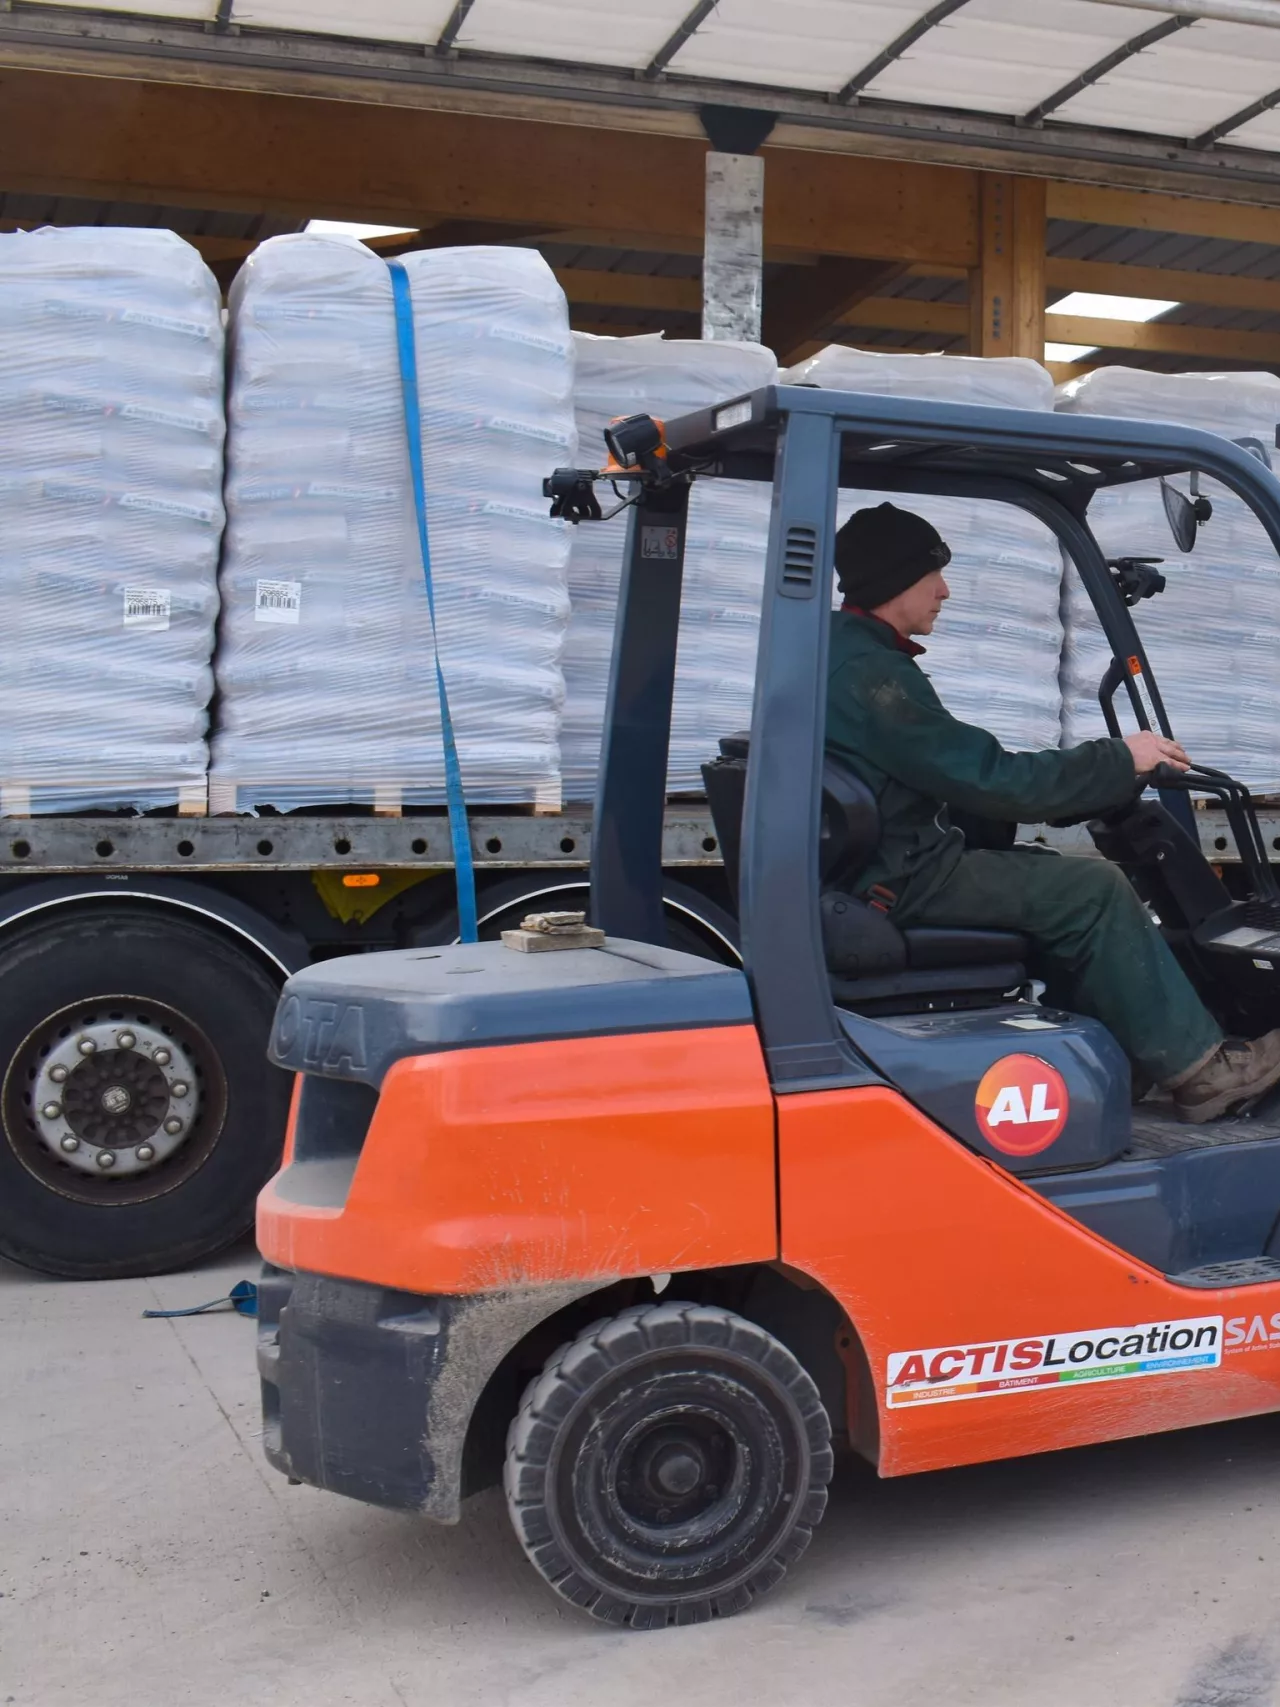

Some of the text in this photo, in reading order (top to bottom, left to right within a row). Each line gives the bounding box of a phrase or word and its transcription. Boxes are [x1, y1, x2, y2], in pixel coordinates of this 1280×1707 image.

[987, 1084, 1060, 1127] AL
[1224, 1346, 1244, 1356] System
[1251, 1344, 1268, 1352] Active
[1145, 1355, 1210, 1370] ENVIRONNEMENT
[1072, 1365, 1127, 1379] AGRICULTURE
[998, 1376, 1040, 1388] BÂTIMENT
[913, 1387, 957, 1400] INDUSTRIE
